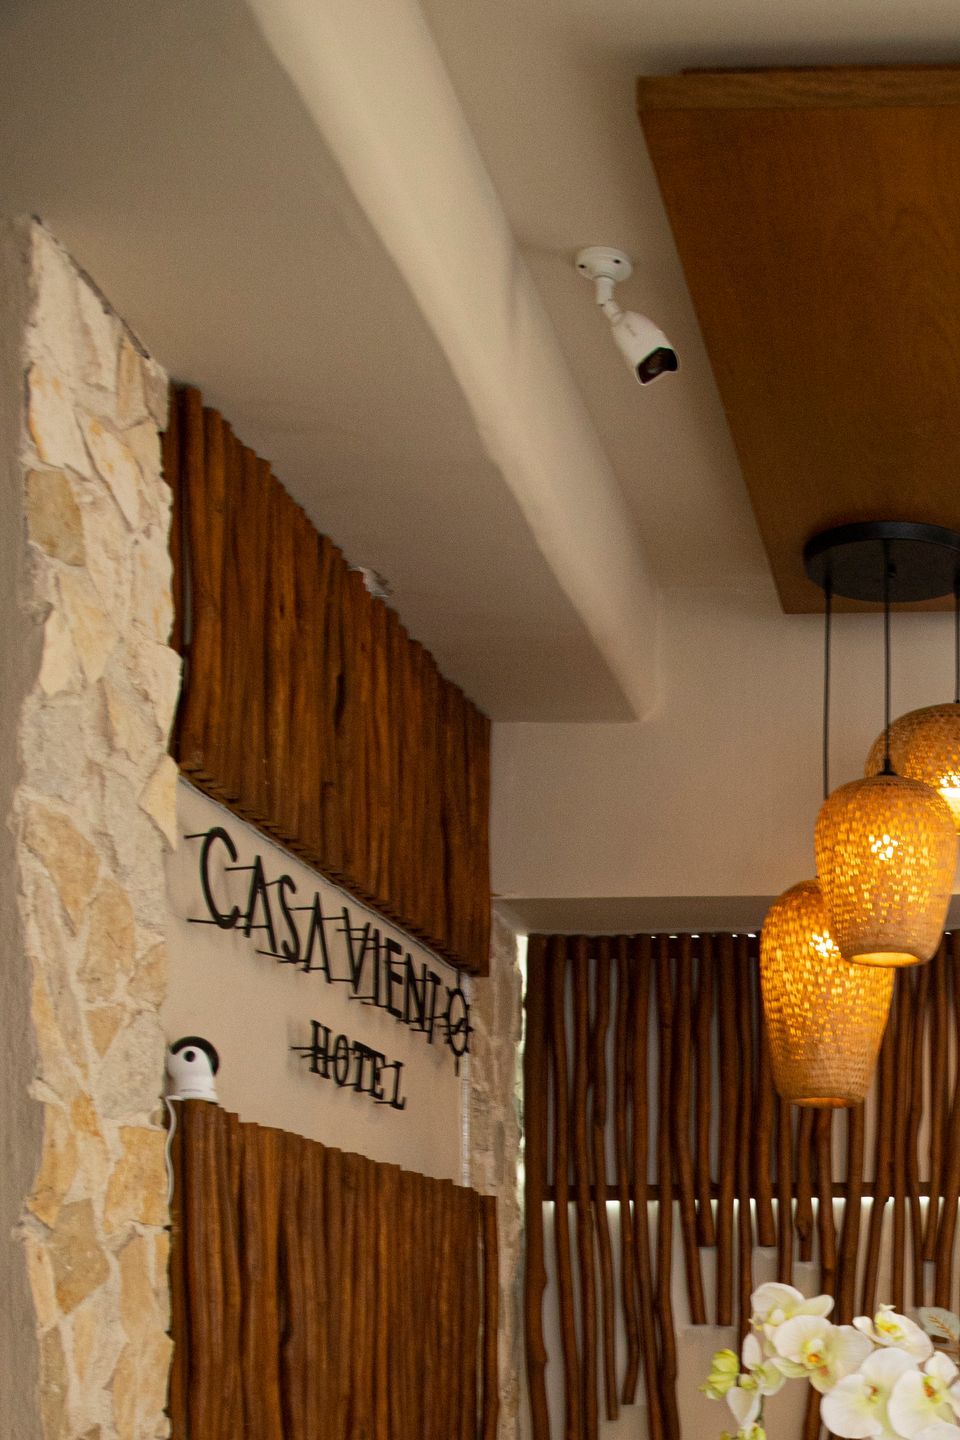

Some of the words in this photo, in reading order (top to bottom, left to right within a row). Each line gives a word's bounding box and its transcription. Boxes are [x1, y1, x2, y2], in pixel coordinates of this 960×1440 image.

[199, 826, 333, 984] CASA
[342, 906, 472, 1060] VIENTO
[309, 1018, 407, 1111] HOTEL
